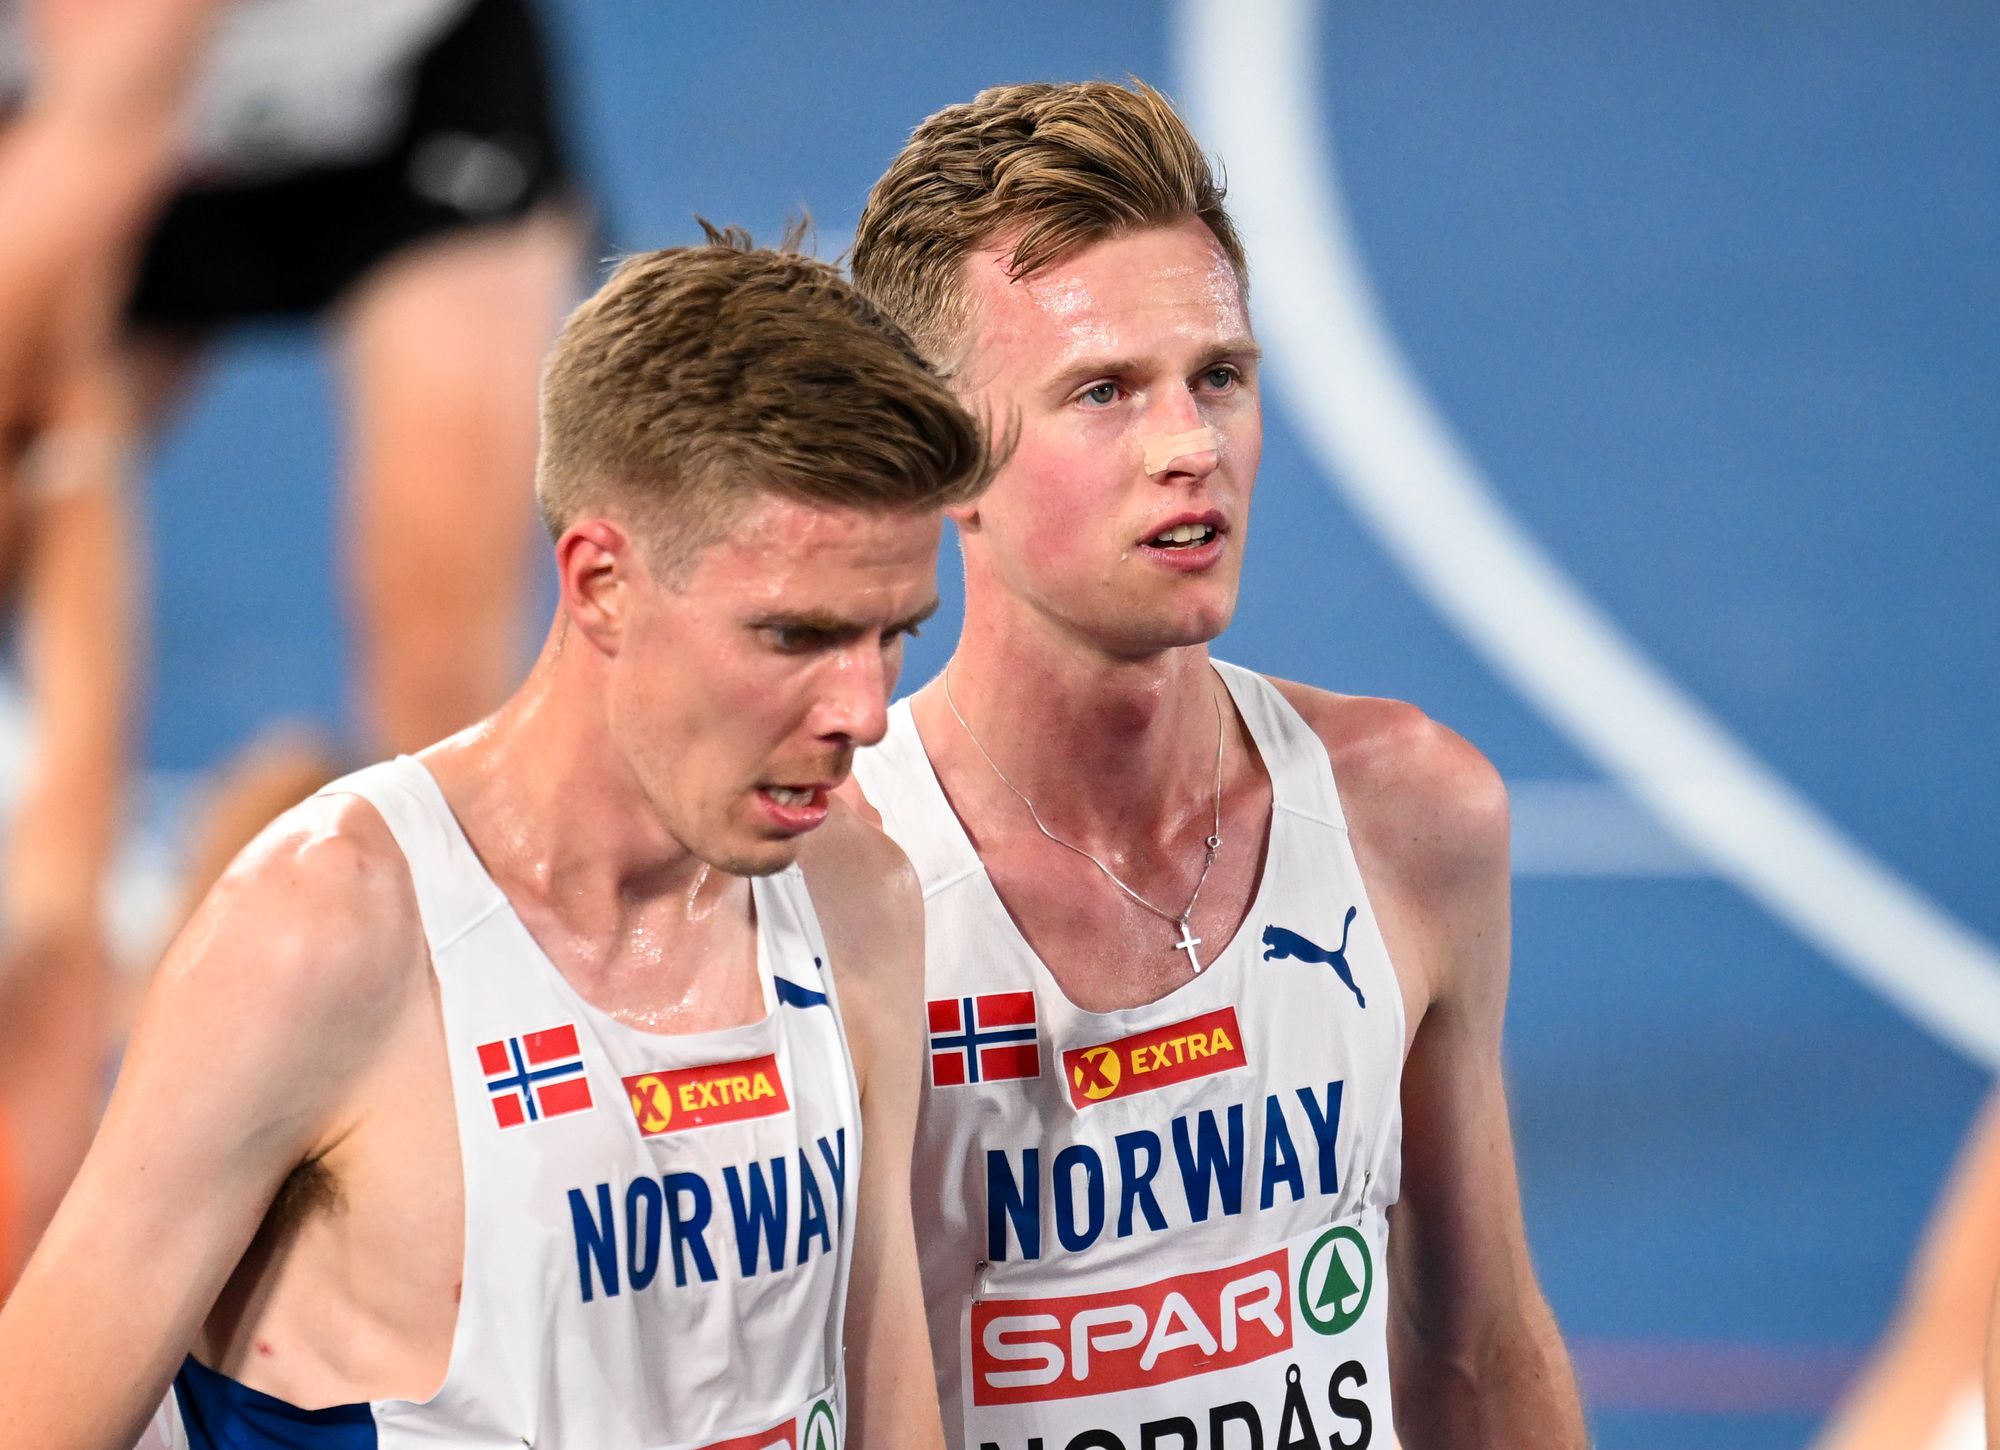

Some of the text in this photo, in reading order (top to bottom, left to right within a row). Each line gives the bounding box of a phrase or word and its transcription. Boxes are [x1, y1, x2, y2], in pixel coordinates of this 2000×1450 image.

[678, 1072, 776, 1112] EXTRA
[1131, 1028, 1234, 1075] EXTRA
[568, 1127, 845, 1303] NORWAY
[987, 1080, 1344, 1262] NORWAY
[982, 1270, 1284, 1388] SPAR
